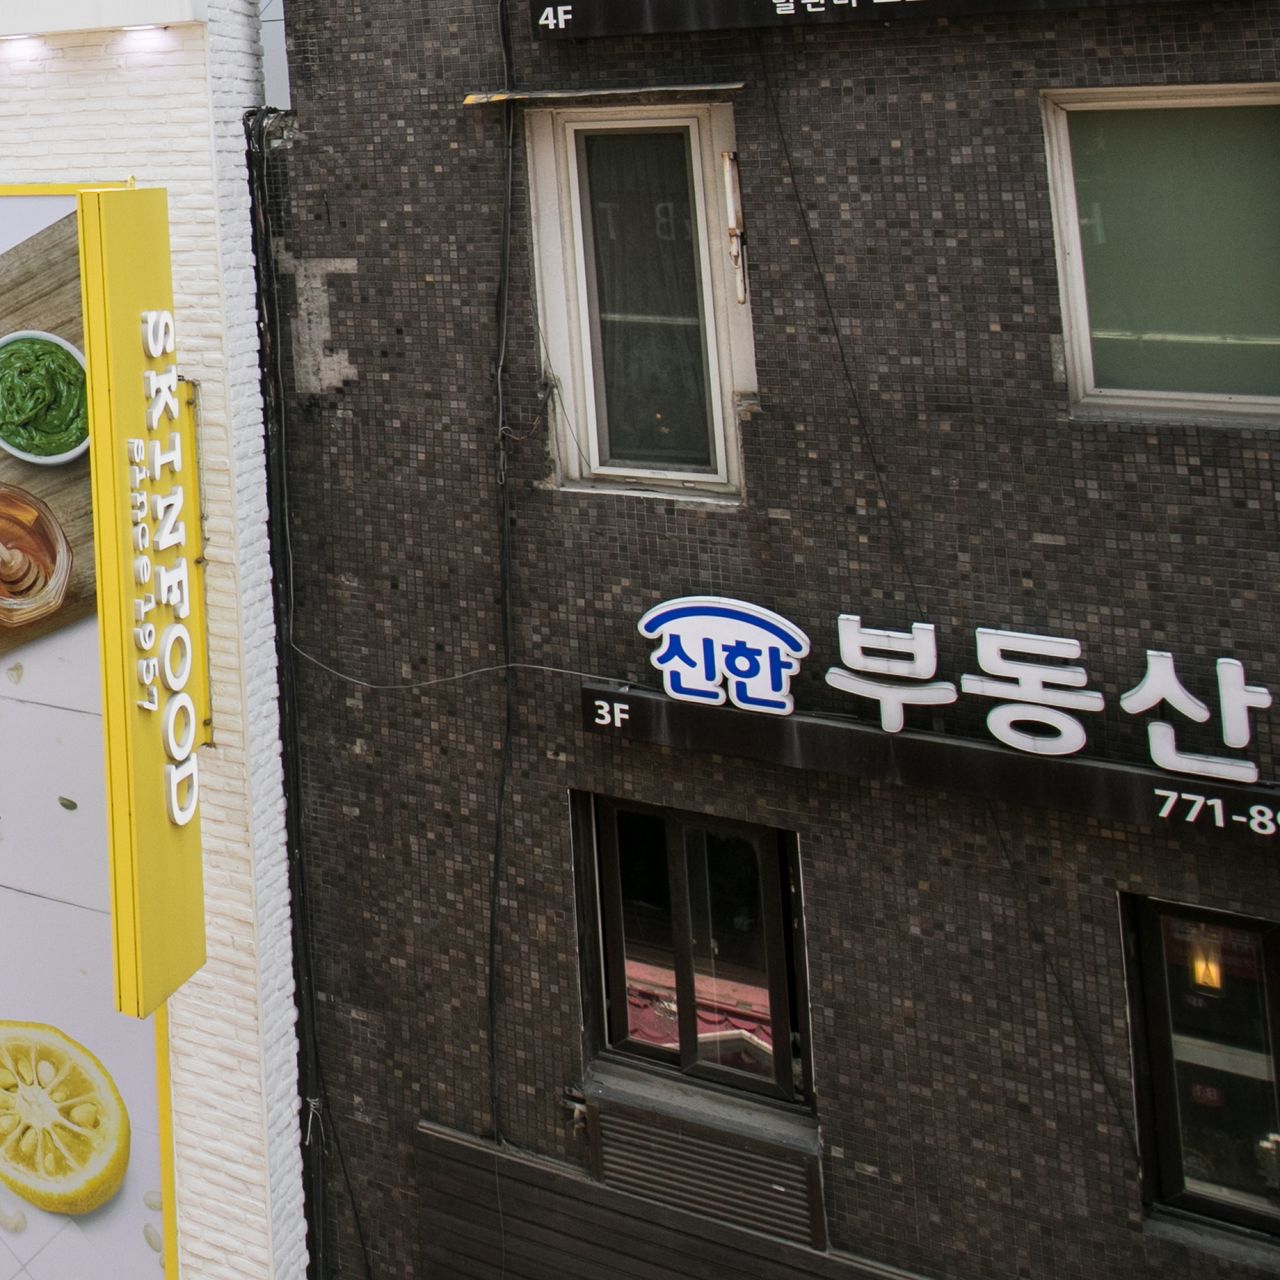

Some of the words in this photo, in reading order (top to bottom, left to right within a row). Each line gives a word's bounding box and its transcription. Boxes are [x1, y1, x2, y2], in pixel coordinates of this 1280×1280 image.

[538, 5, 573, 30] 4F
[140, 310, 199, 827] SKINFOOD
[594, 700, 630, 728] 3F
[655, 633, 793, 711] 신한
[824, 614, 1272, 784] 부동산
[1154, 788, 1280, 835] 771-8
